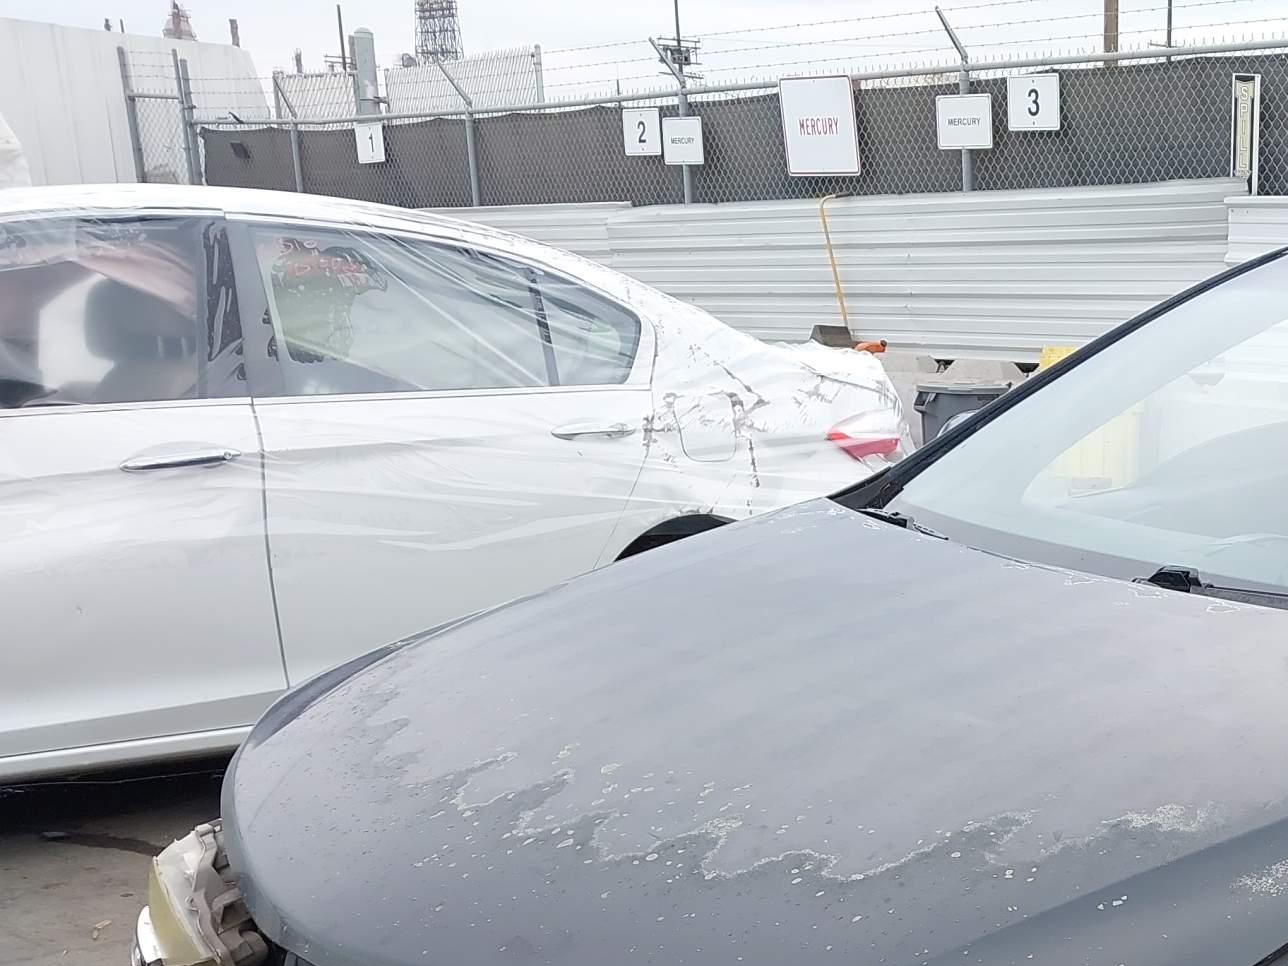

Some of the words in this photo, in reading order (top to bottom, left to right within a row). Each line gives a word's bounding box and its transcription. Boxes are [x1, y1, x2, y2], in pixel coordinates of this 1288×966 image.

[1027, 88, 1040, 117] 3
[637, 120, 647, 144] 2
[799, 116, 840, 137] MERCURY
[947, 117, 981, 127] MERCURY
[1239, 86, 1249, 169] SPILL
[368, 132, 375, 153] 1
[670, 136, 695, 145] MERCURY
